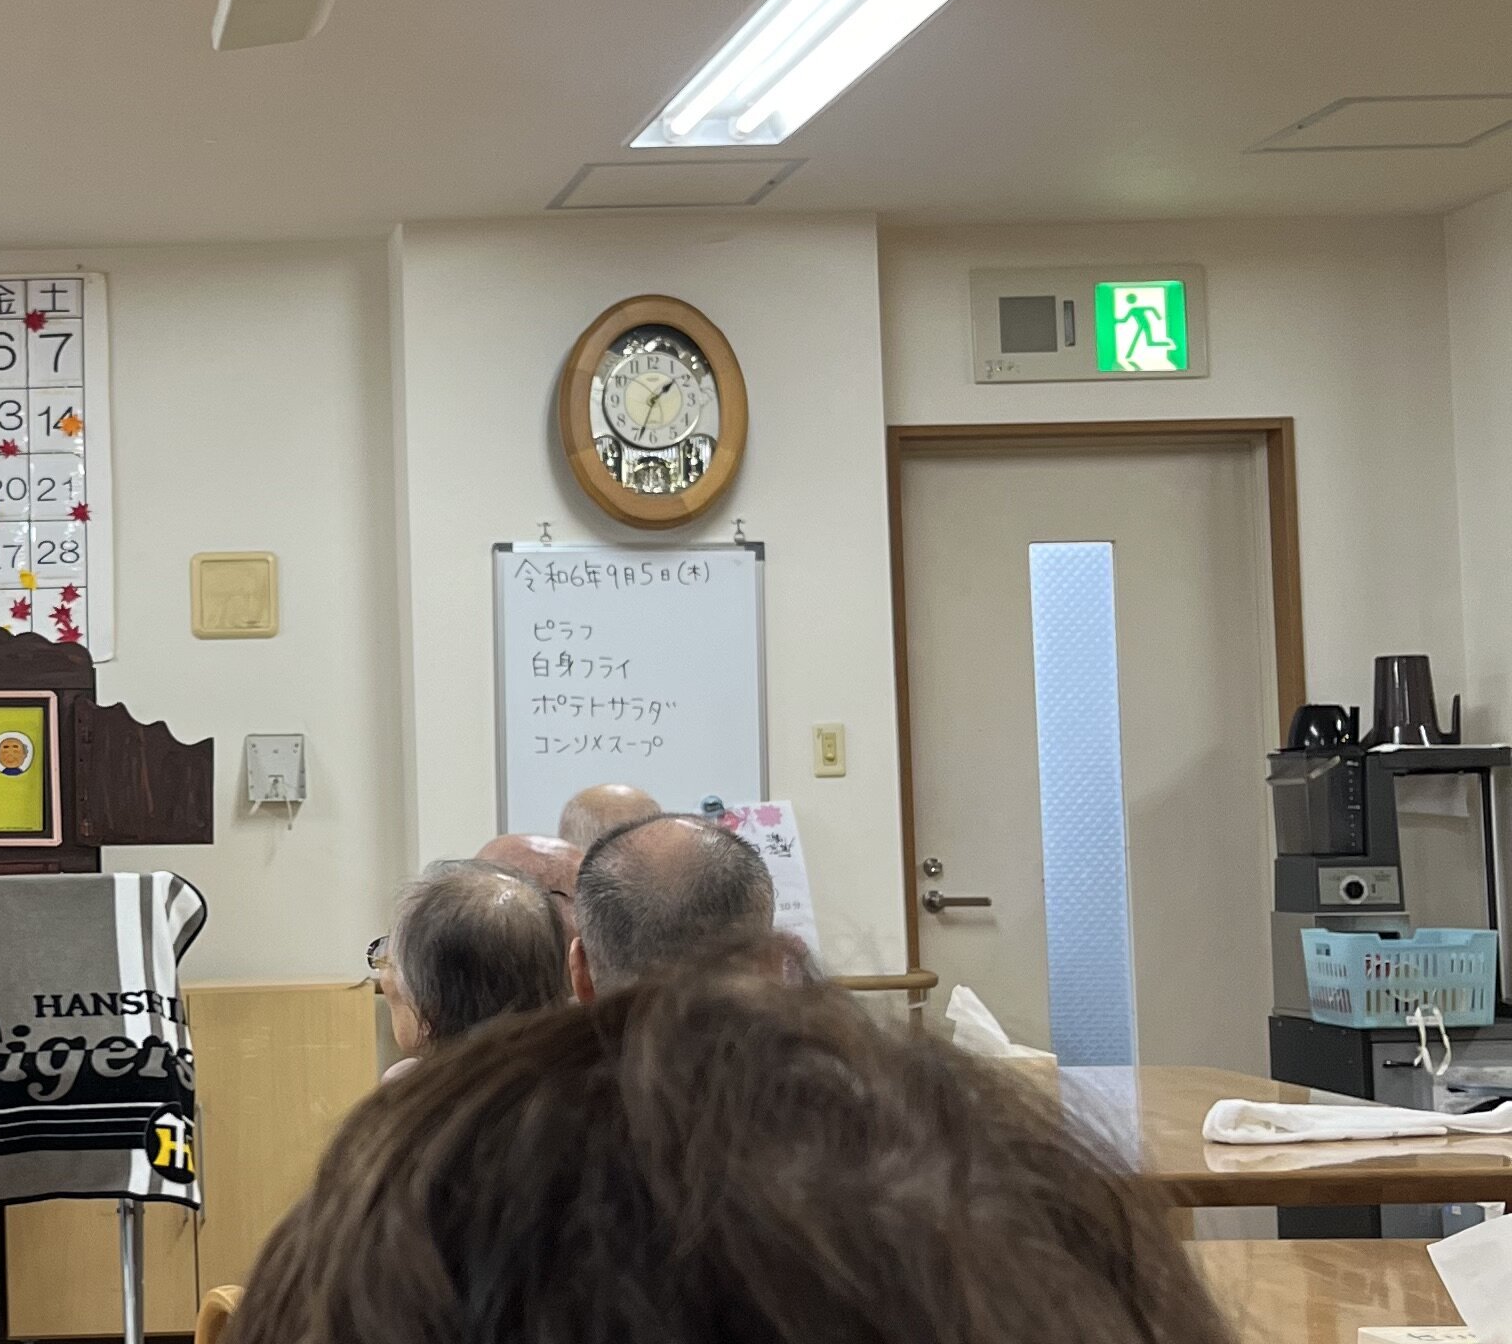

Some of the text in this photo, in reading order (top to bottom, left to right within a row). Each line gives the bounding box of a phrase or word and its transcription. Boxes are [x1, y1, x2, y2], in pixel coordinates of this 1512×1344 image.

[39, 283, 70, 314] 土
[39, 333, 73, 373] 7
[38, 405, 76, 435] 14
[37, 476, 75, 502] 21
[36, 539, 80, 565] 28
[534, 619, 593, 642] ピラフ
[532, 651, 630, 680] 白身フライ
[531, 694, 677, 725] ポテトサラダ
[534, 735, 664, 757] コンソメスープ
[33, 990, 189, 1025] HANSHI
